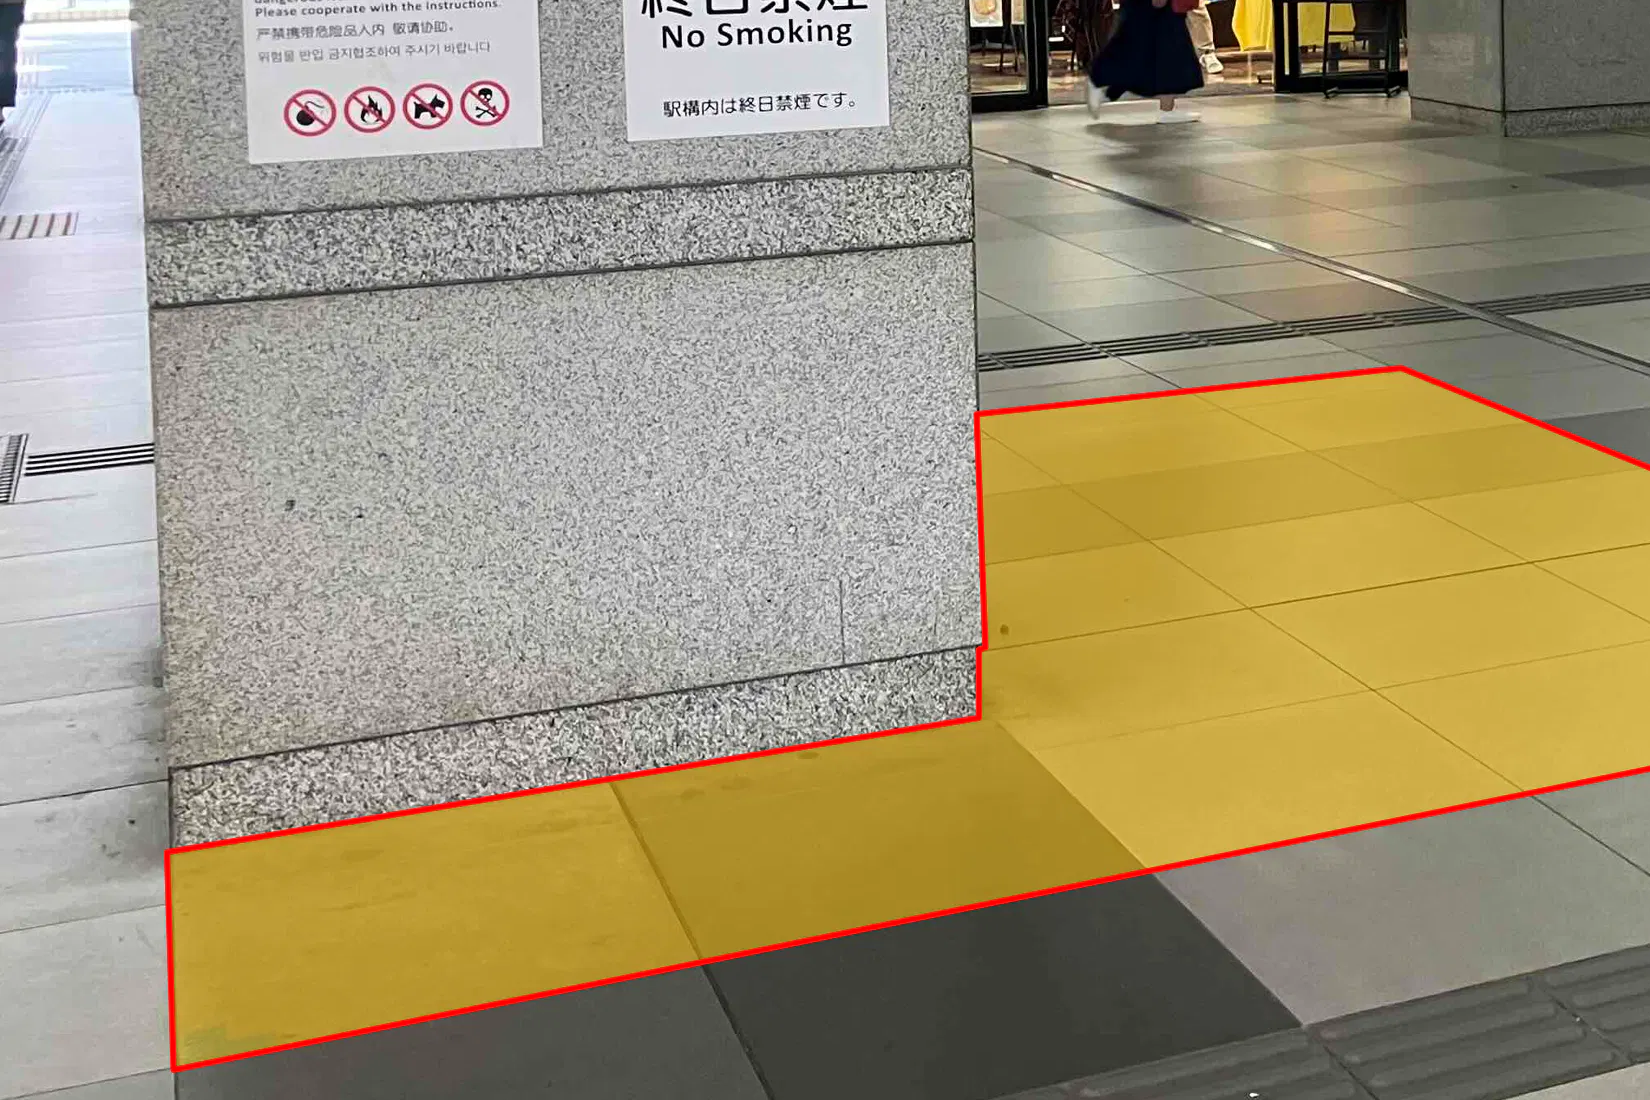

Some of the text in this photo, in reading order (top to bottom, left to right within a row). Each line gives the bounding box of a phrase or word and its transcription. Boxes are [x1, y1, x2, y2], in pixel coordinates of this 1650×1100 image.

[255, 7, 298, 18] Please
[301, 4, 367, 17] cooperate
[370, 2, 398, 13] with
[401, 1, 423, 12] the
[661, 18, 853, 49] No Smoking
[663, 91, 856, 118] 駅構内は終日禁煙です。
